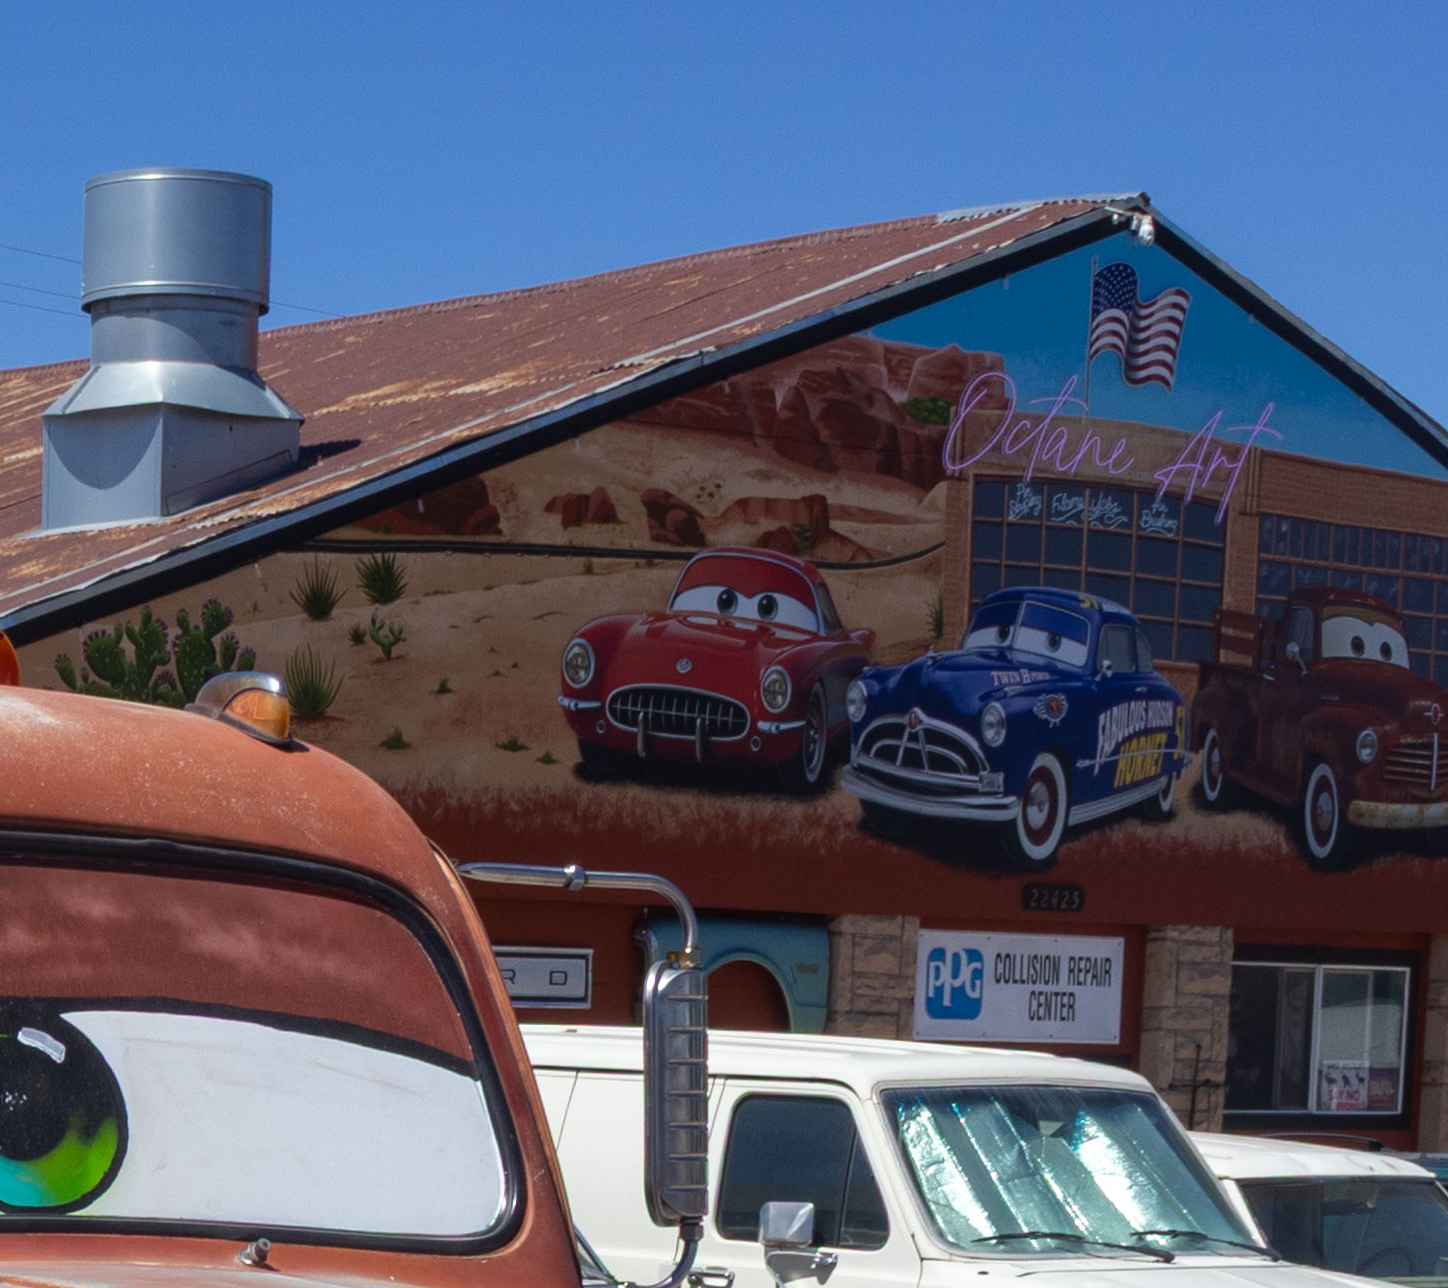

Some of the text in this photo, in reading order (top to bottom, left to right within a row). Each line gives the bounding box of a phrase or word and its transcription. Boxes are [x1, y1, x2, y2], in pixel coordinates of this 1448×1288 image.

[943, 371, 1284, 524] Octane Art
[1094, 701, 1147, 776] FABULOUS
[1114, 733, 1168, 789] HORNET
[994, 953, 1113, 988] COLLISION REPAIR
[1028, 990, 1076, 1022] CENTER
